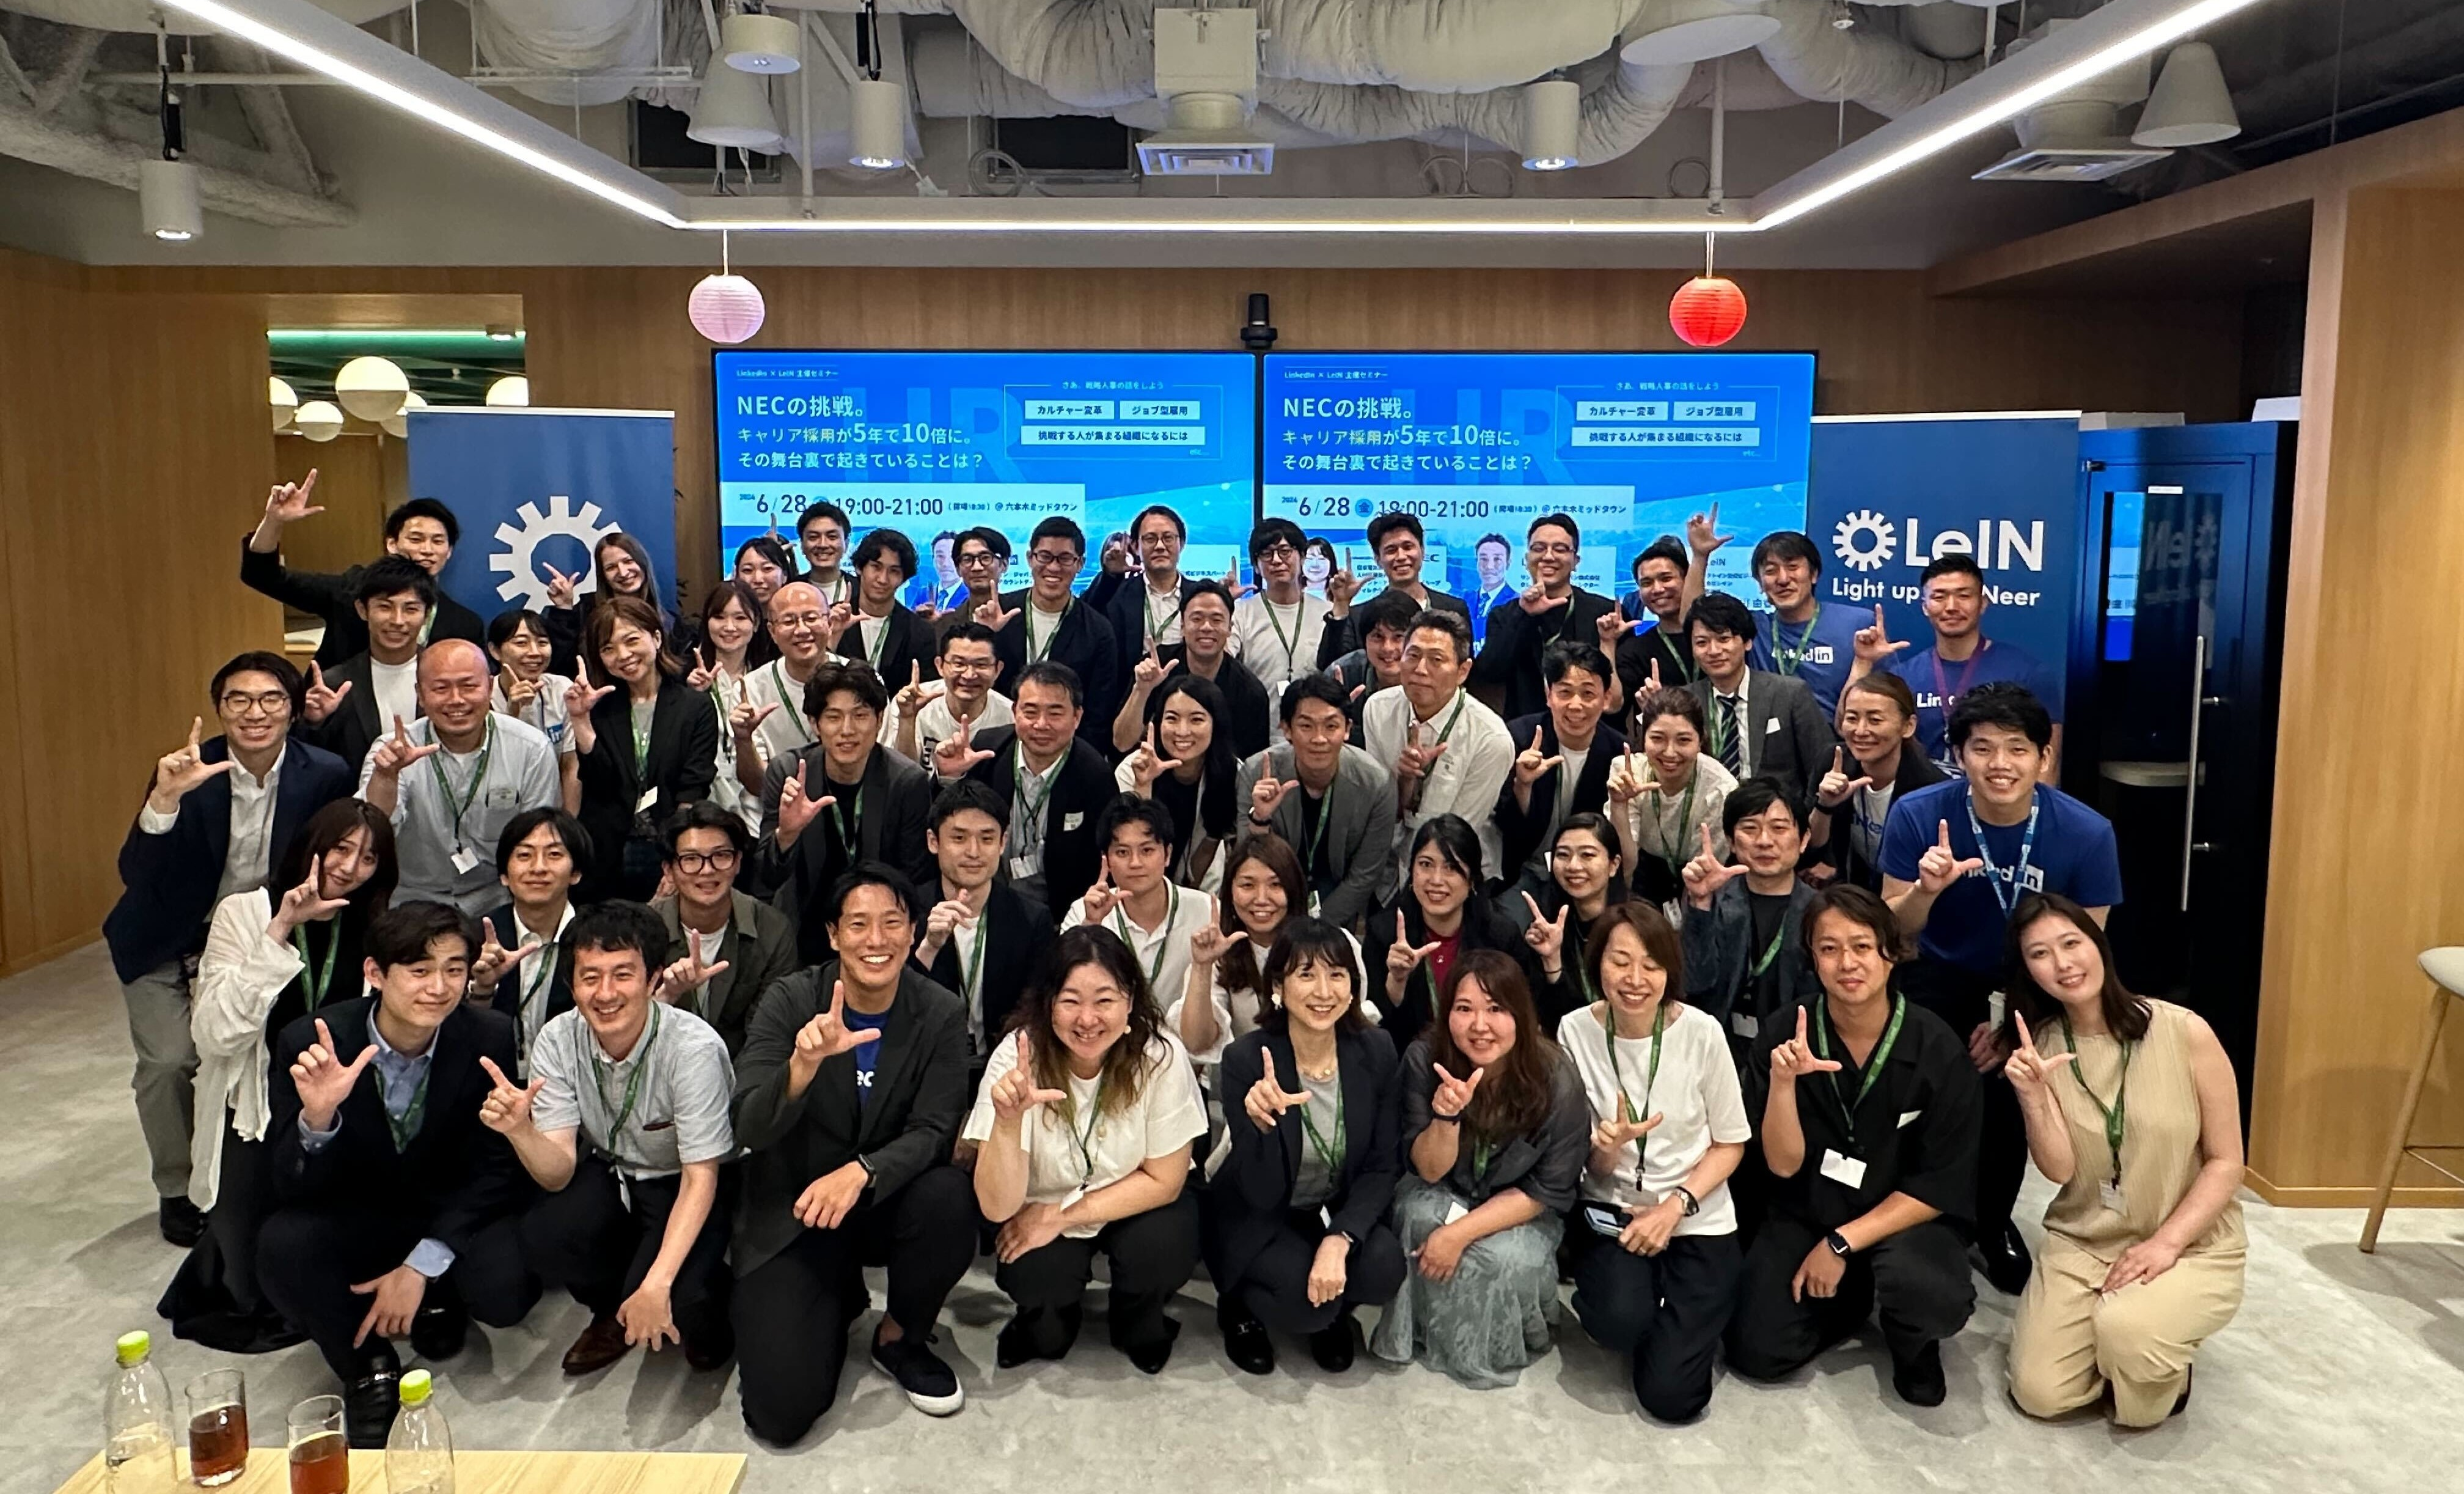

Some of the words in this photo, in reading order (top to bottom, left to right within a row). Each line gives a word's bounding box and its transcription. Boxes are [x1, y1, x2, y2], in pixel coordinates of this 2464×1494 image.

[738, 395, 863, 417] NECの挑戦。
[1284, 397, 1412, 419] NECの挑戦。
[1906, 518, 2044, 571] LeIN
[1833, 578, 1884, 602] Light
[1892, 586, 1920, 605] up
